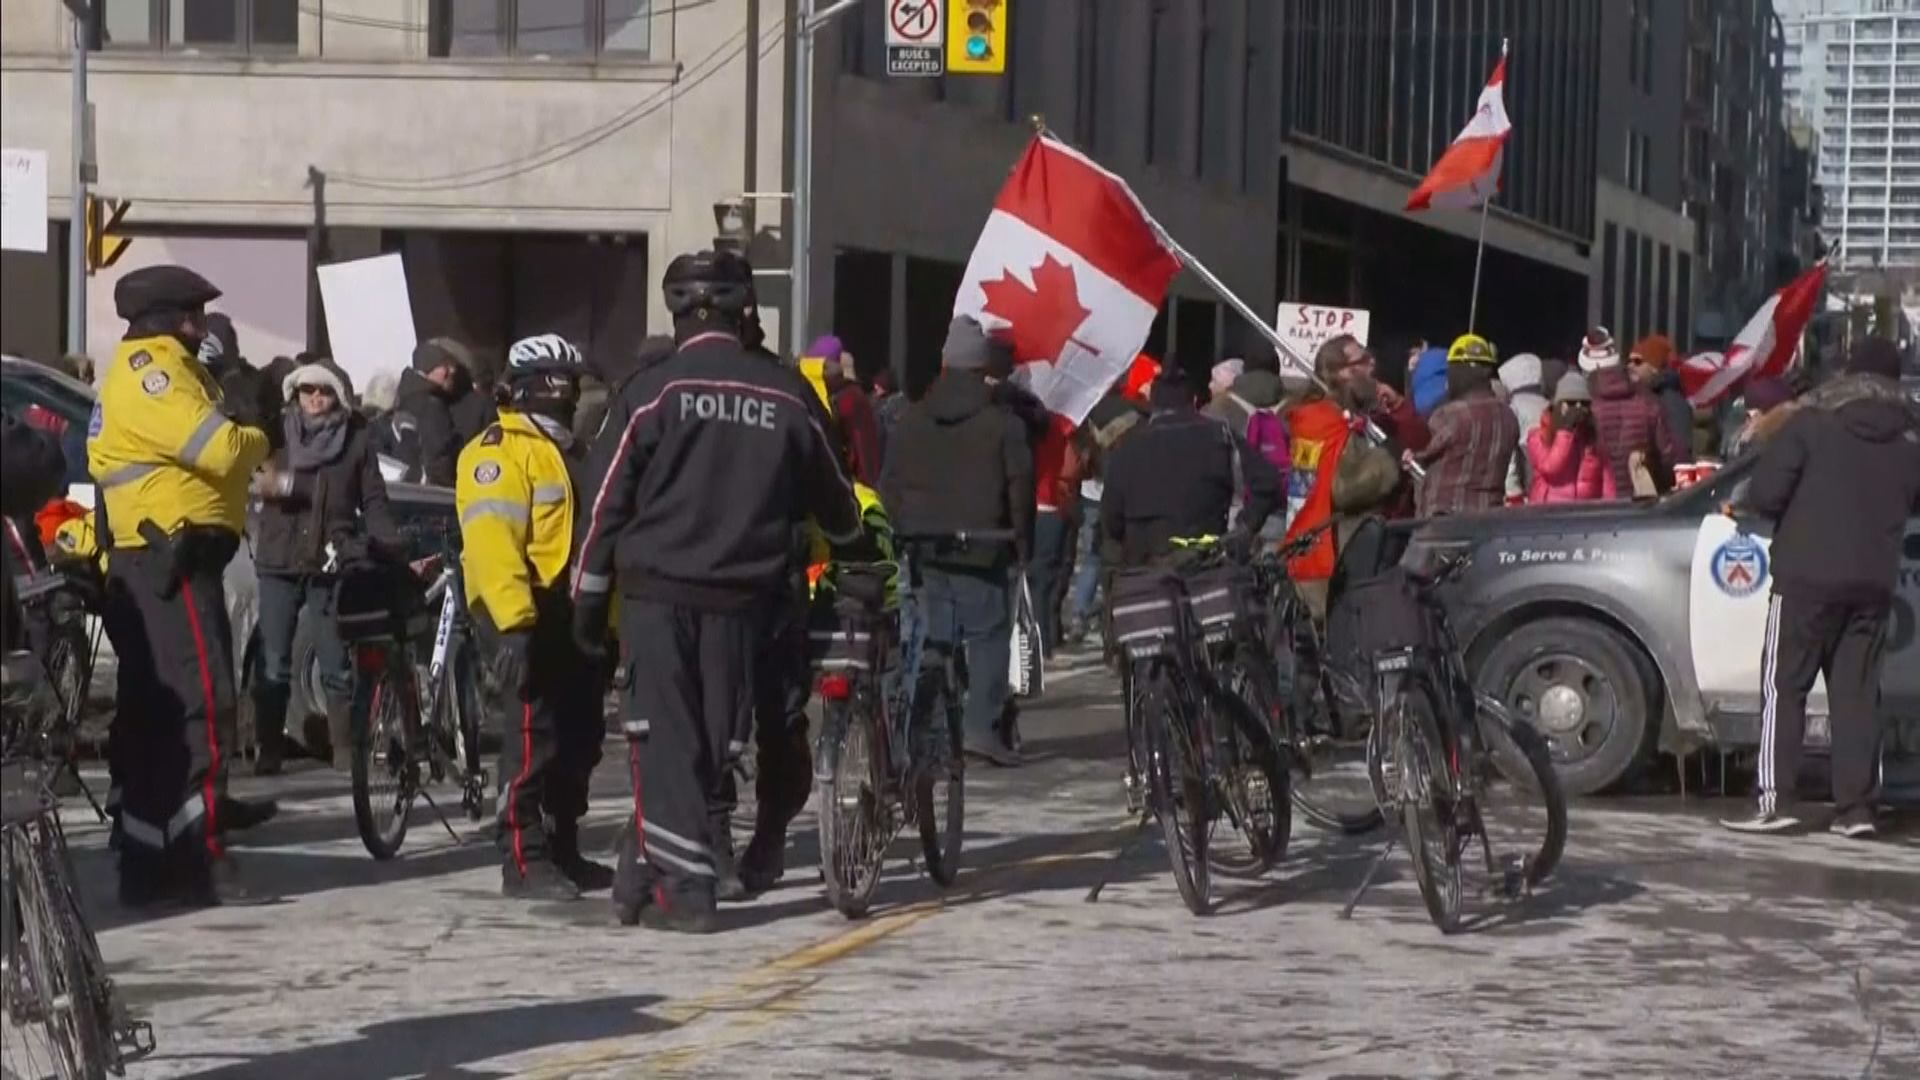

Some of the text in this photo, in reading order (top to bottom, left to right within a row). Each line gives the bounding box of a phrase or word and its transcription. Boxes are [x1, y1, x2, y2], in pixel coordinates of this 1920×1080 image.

[899, 49, 930, 59] BUSES
[891, 60, 939, 71] EXCEPTED
[1298, 305, 1354, 328] STOP
[680, 393, 776, 430] POLICE
[1499, 551, 1516, 563] To
[1521, 550, 1566, 561] Serve
[1573, 548, 1585, 560] &
